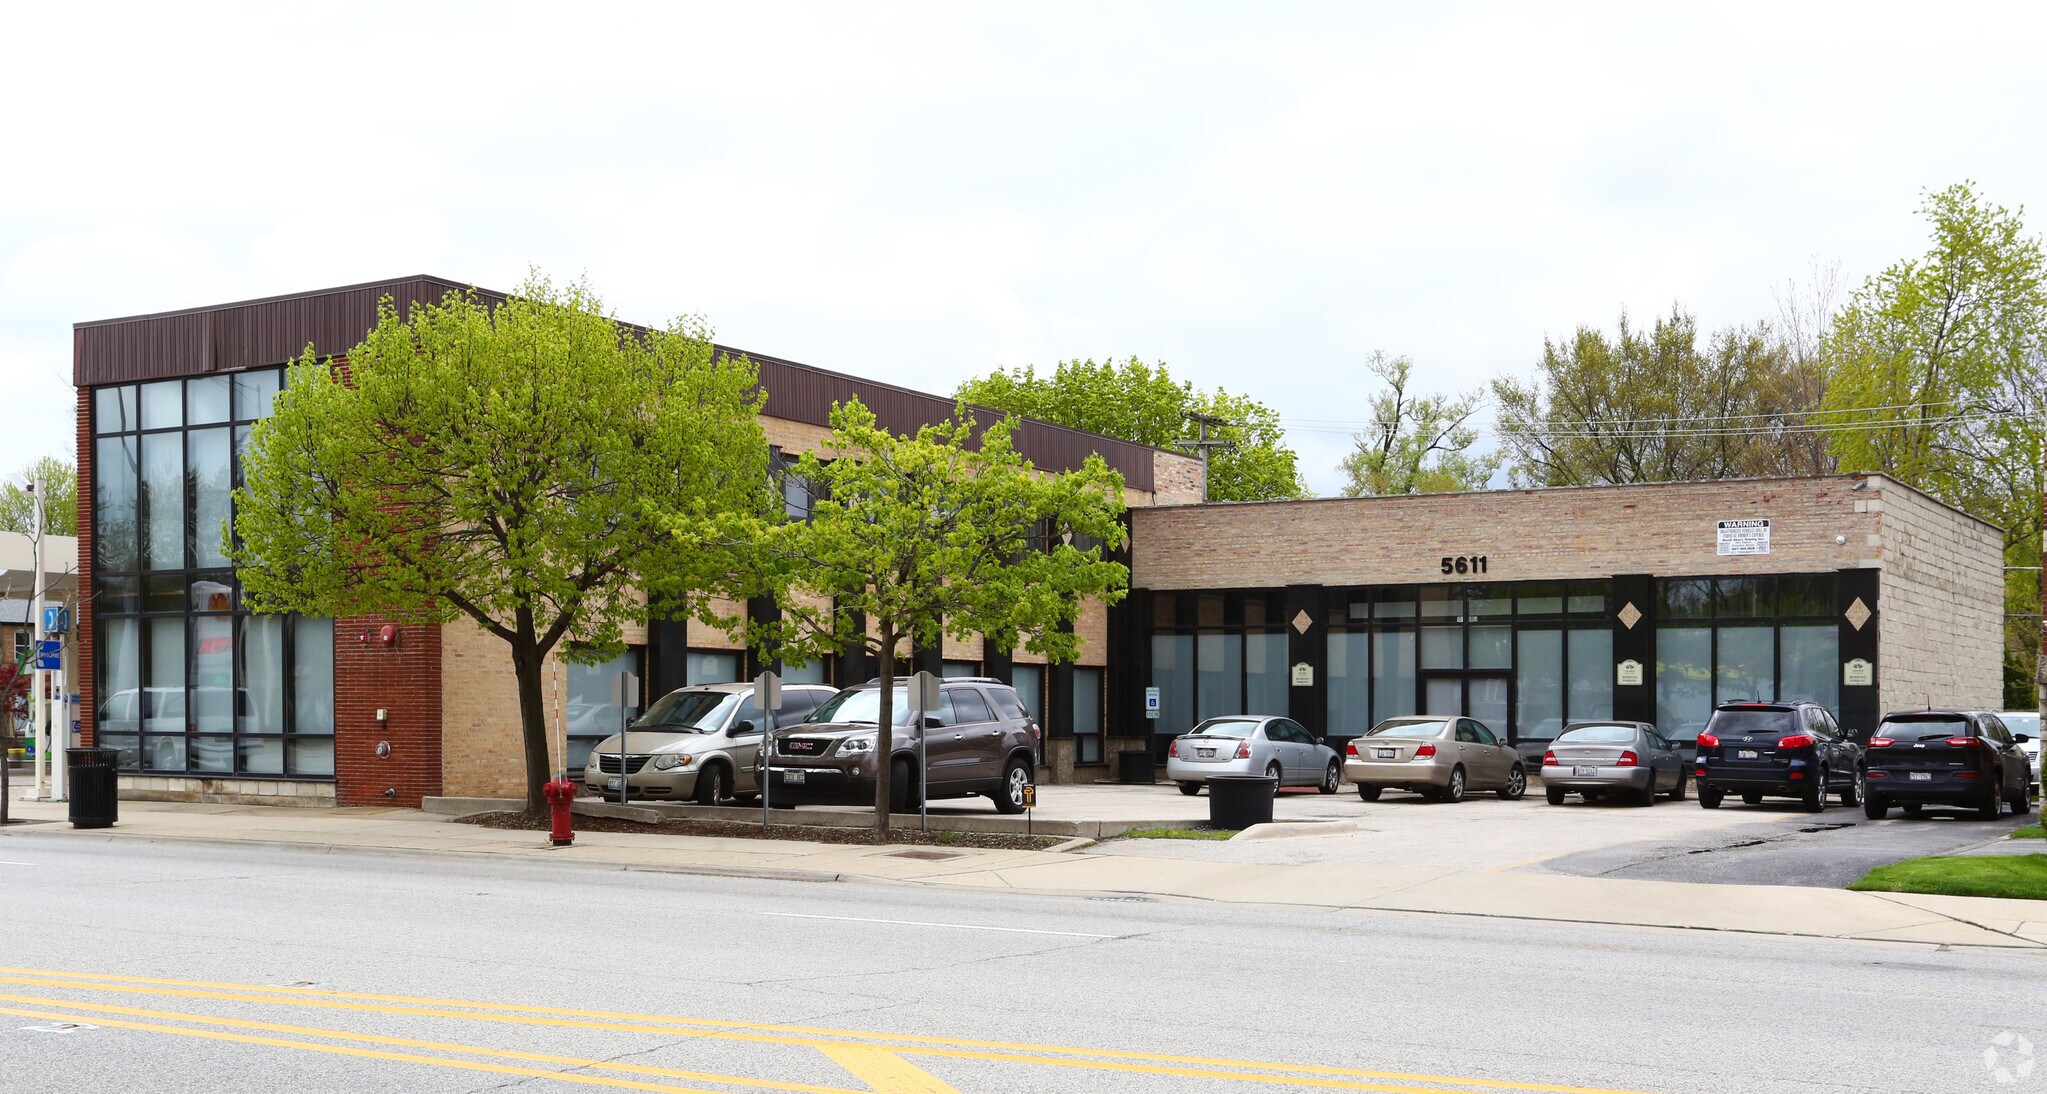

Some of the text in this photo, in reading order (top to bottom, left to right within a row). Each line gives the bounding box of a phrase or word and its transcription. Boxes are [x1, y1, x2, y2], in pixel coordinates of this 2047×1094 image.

[1724, 520, 1764, 528] WARNING
[1441, 556, 1487, 574] 5611
[40, 651, 60, 659] PHONE
[789, 742, 813, 750] GMC
